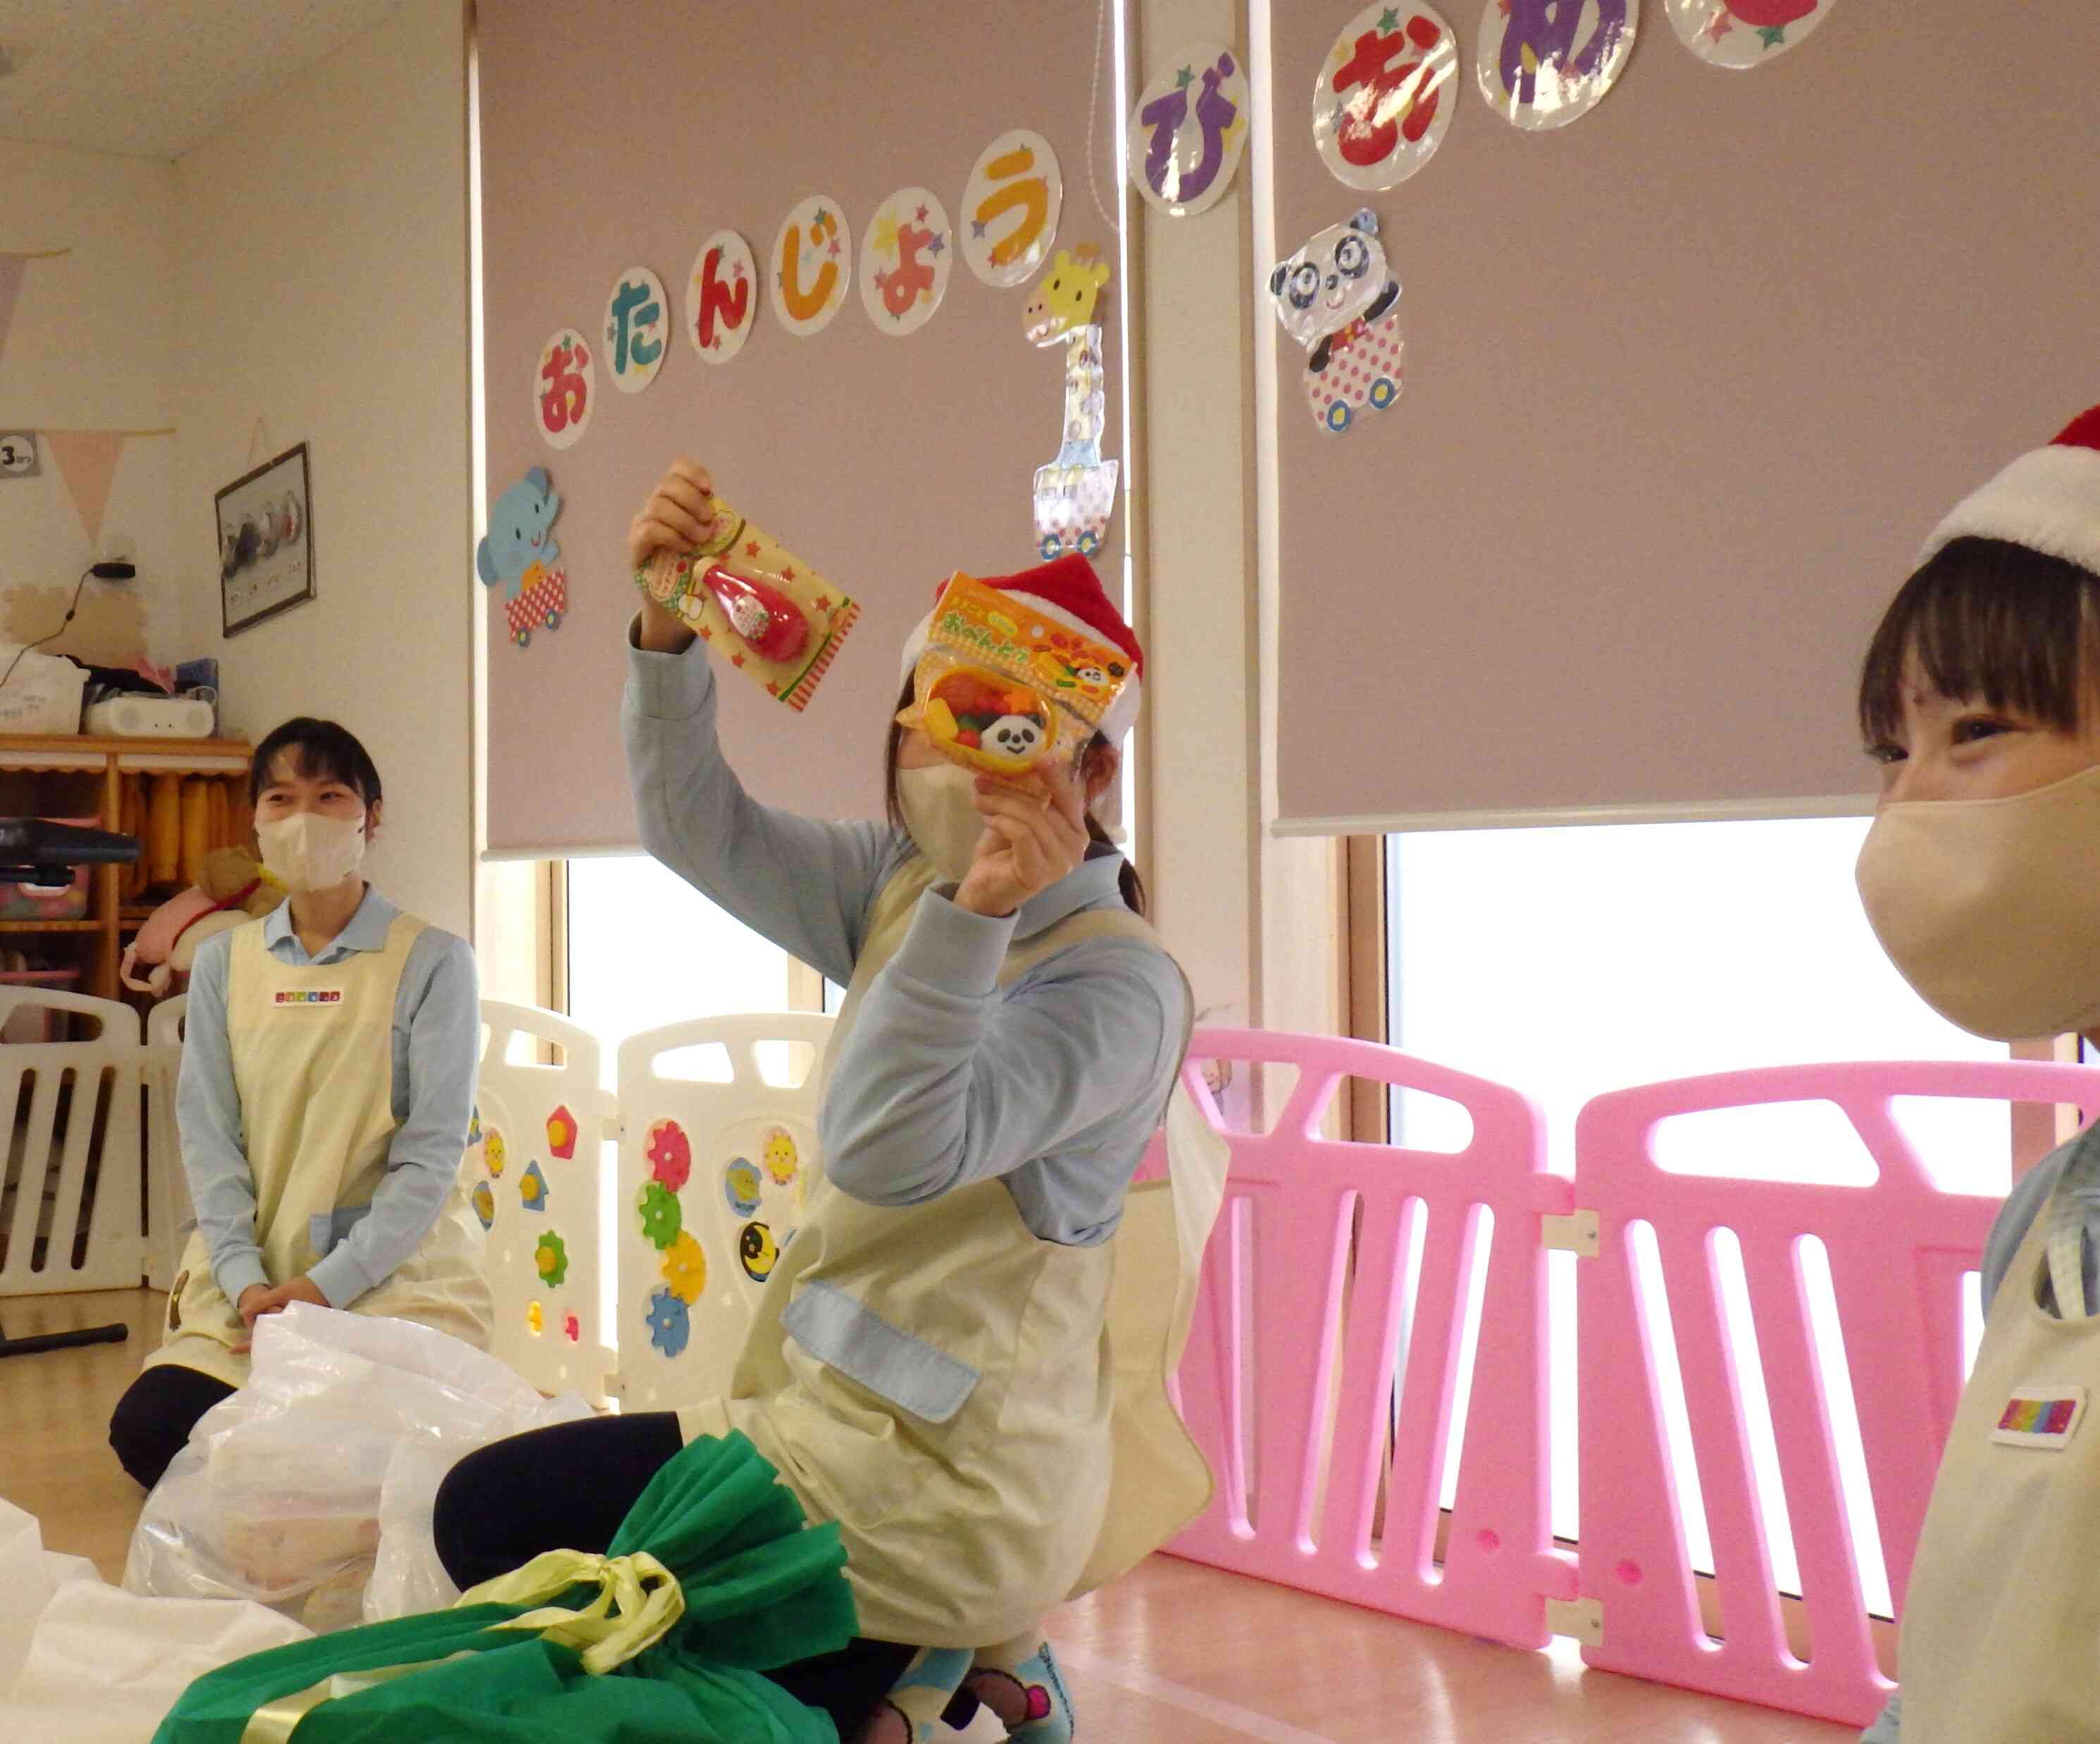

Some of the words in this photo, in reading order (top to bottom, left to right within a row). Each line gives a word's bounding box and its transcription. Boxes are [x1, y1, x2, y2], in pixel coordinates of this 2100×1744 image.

[540, 51, 1236, 433] おたんじょうび
[941, 610, 1031, 665] おべんとう
